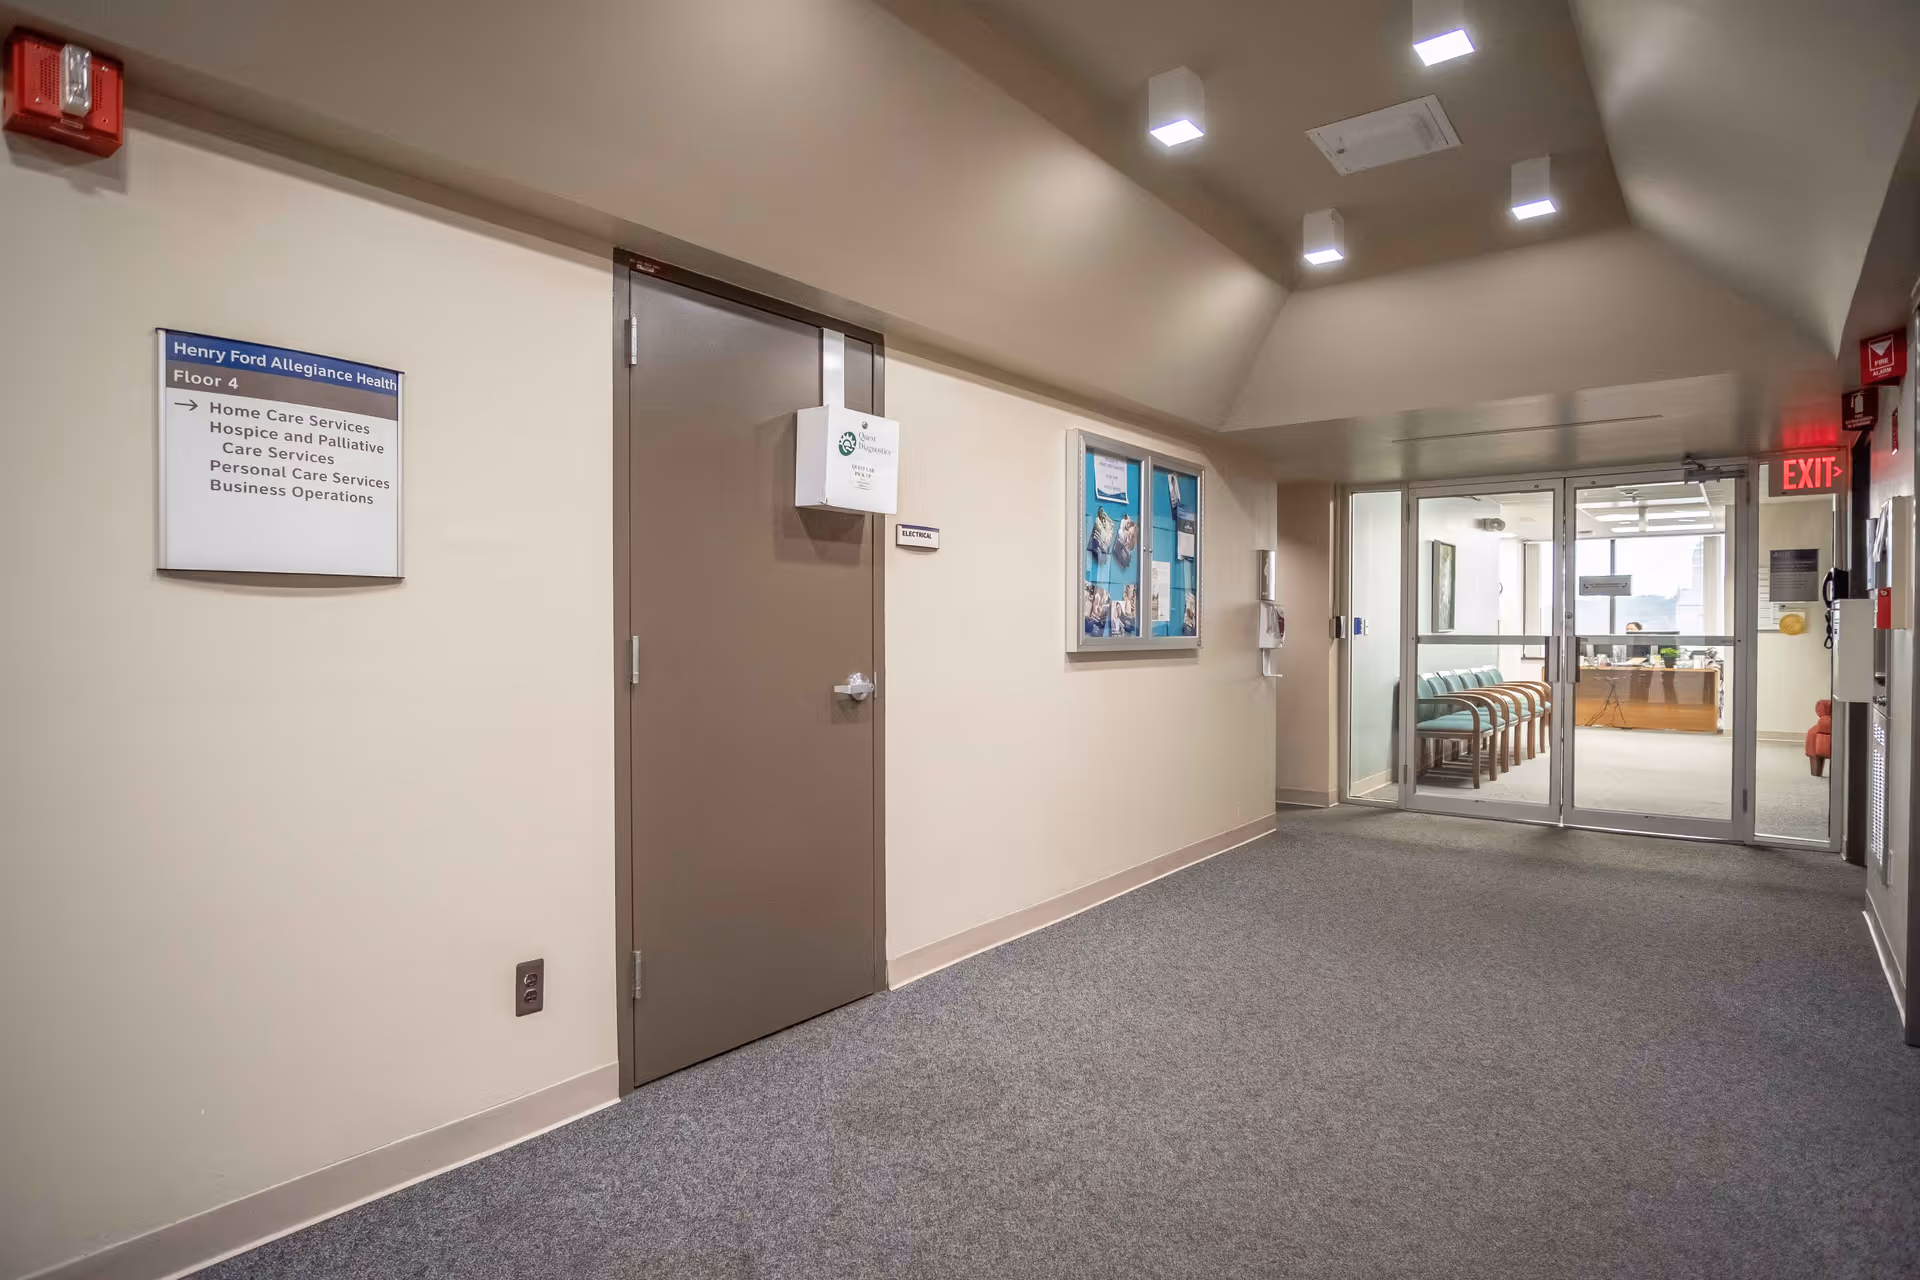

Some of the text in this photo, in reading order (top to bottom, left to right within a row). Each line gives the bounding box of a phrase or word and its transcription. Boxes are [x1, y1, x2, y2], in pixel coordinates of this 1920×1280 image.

[174, 342, 397, 391] Henry Ford Allegiance Health
[1872, 367, 1892, 376] ALARM
[1874, 357, 1888, 366] FIRE
[173, 369, 239, 390] Floor 4
[210, 402, 370, 435] Home Care Services
[210, 421, 385, 454] Hospice and Palliative
[858, 442, 891, 455] Diagnostics
[859, 432, 876, 442] Quest
[222, 442, 335, 465] Care Services
[210, 460, 390, 489] Personal Care Services
[1783, 456, 1836, 490] EXIT
[210, 479, 374, 505] Business Operations
[902, 530, 932, 539] ELECTRICAL
